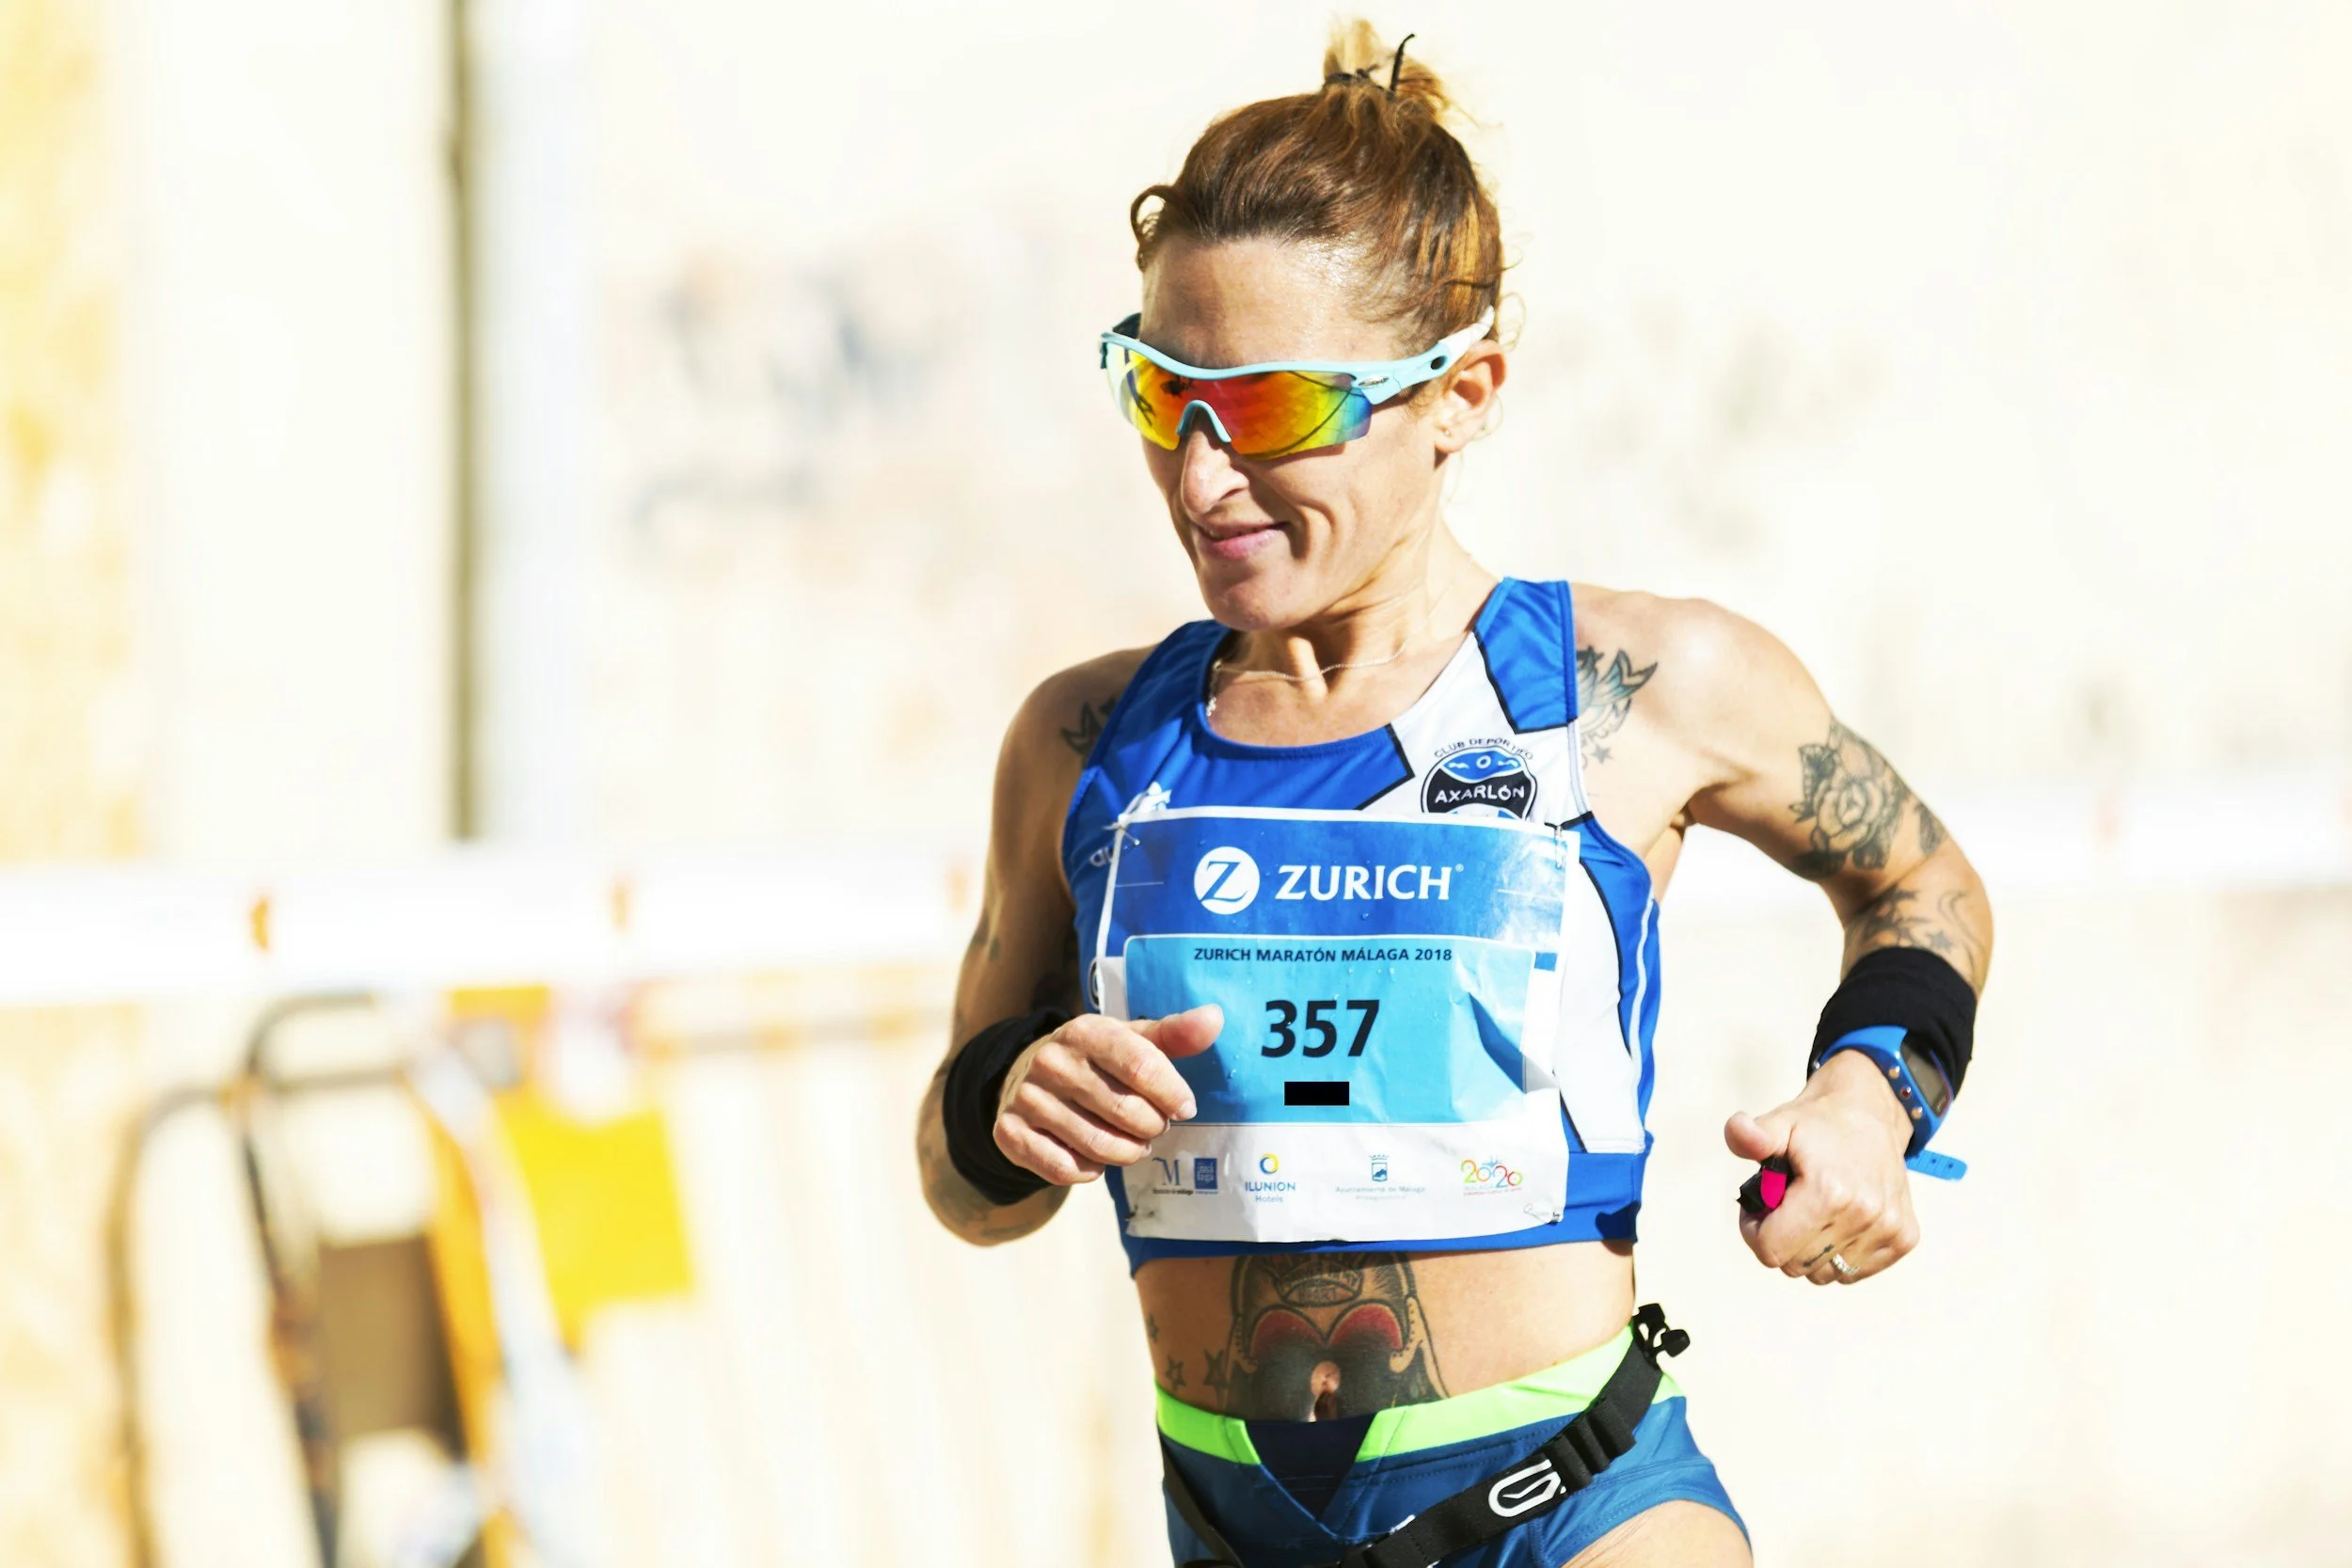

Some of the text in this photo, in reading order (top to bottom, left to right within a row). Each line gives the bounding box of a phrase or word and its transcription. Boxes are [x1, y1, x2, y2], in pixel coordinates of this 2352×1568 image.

[1435, 740, 1466, 758] CLUB
[1435, 783, 1525, 804] AXARLÓN
[1193, 946, 1453, 962] ZURICH MARATÓN MÁLAGA 2018
[1261, 999, 1380, 1058] 357
[1460, 1159, 1523, 1188] 2020
[1245, 1181, 1296, 1192] ILUNION
[1255, 1195, 1283, 1203] Hotels
